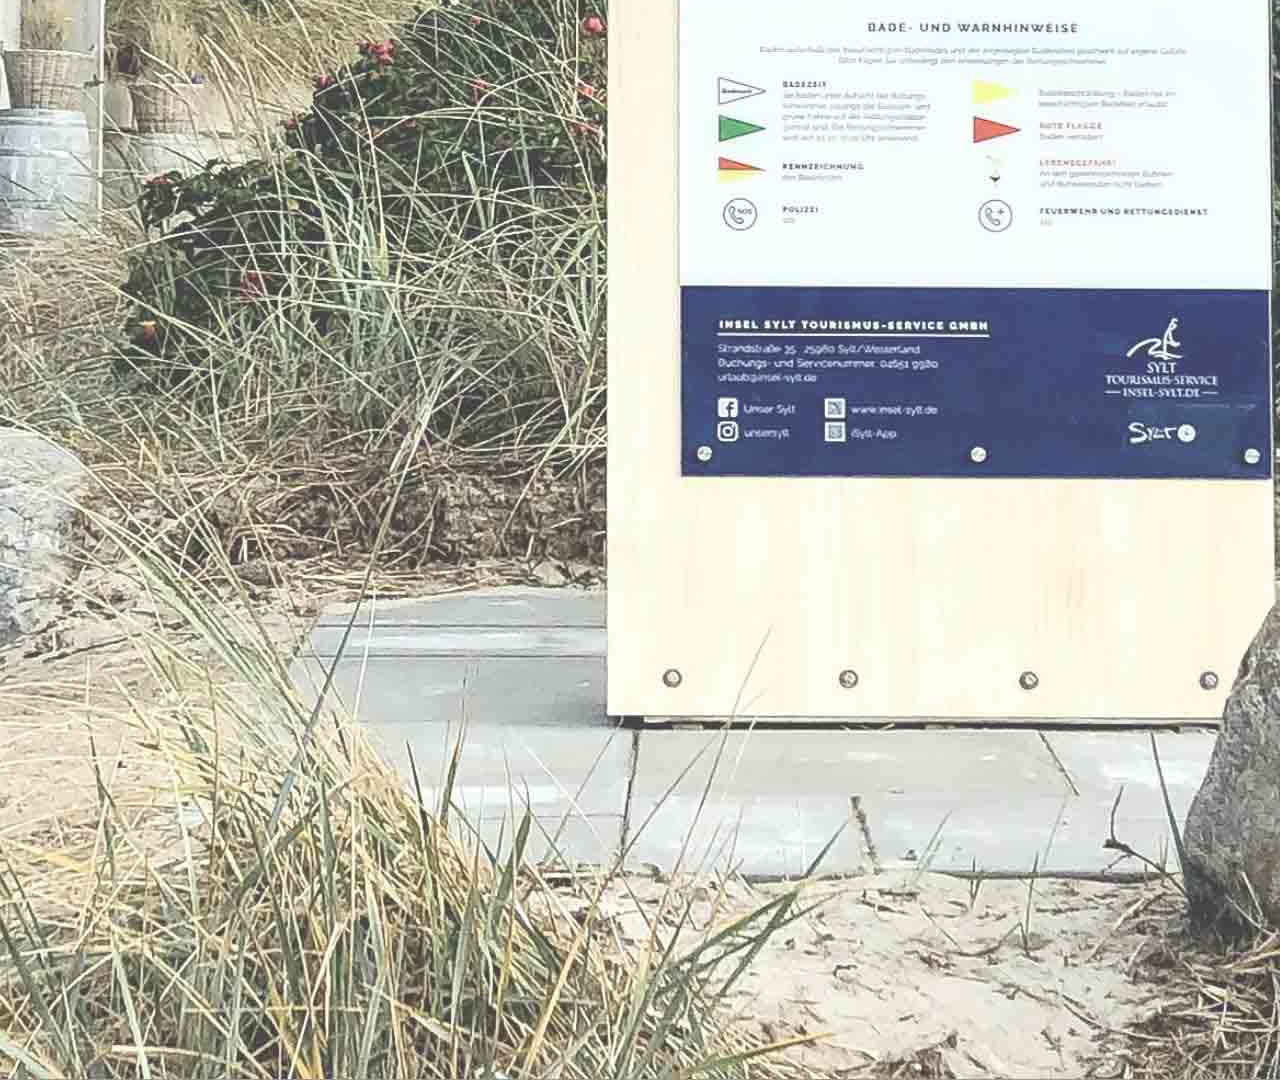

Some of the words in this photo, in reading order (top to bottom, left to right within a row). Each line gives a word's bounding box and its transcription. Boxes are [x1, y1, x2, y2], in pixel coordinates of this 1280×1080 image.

[920, 23, 951, 32] UND
[959, 23, 1079, 33] WARNHINWEISE
[1100, 208, 1121, 216] UND
[720, 320, 759, 330] INSEL
[764, 320, 796, 330] SYLT
[774, 359, 794, 368] und
[1147, 362, 1178, 374] SYLT
[1105, 375, 1217, 385] TOURISMUS-SERVICE
